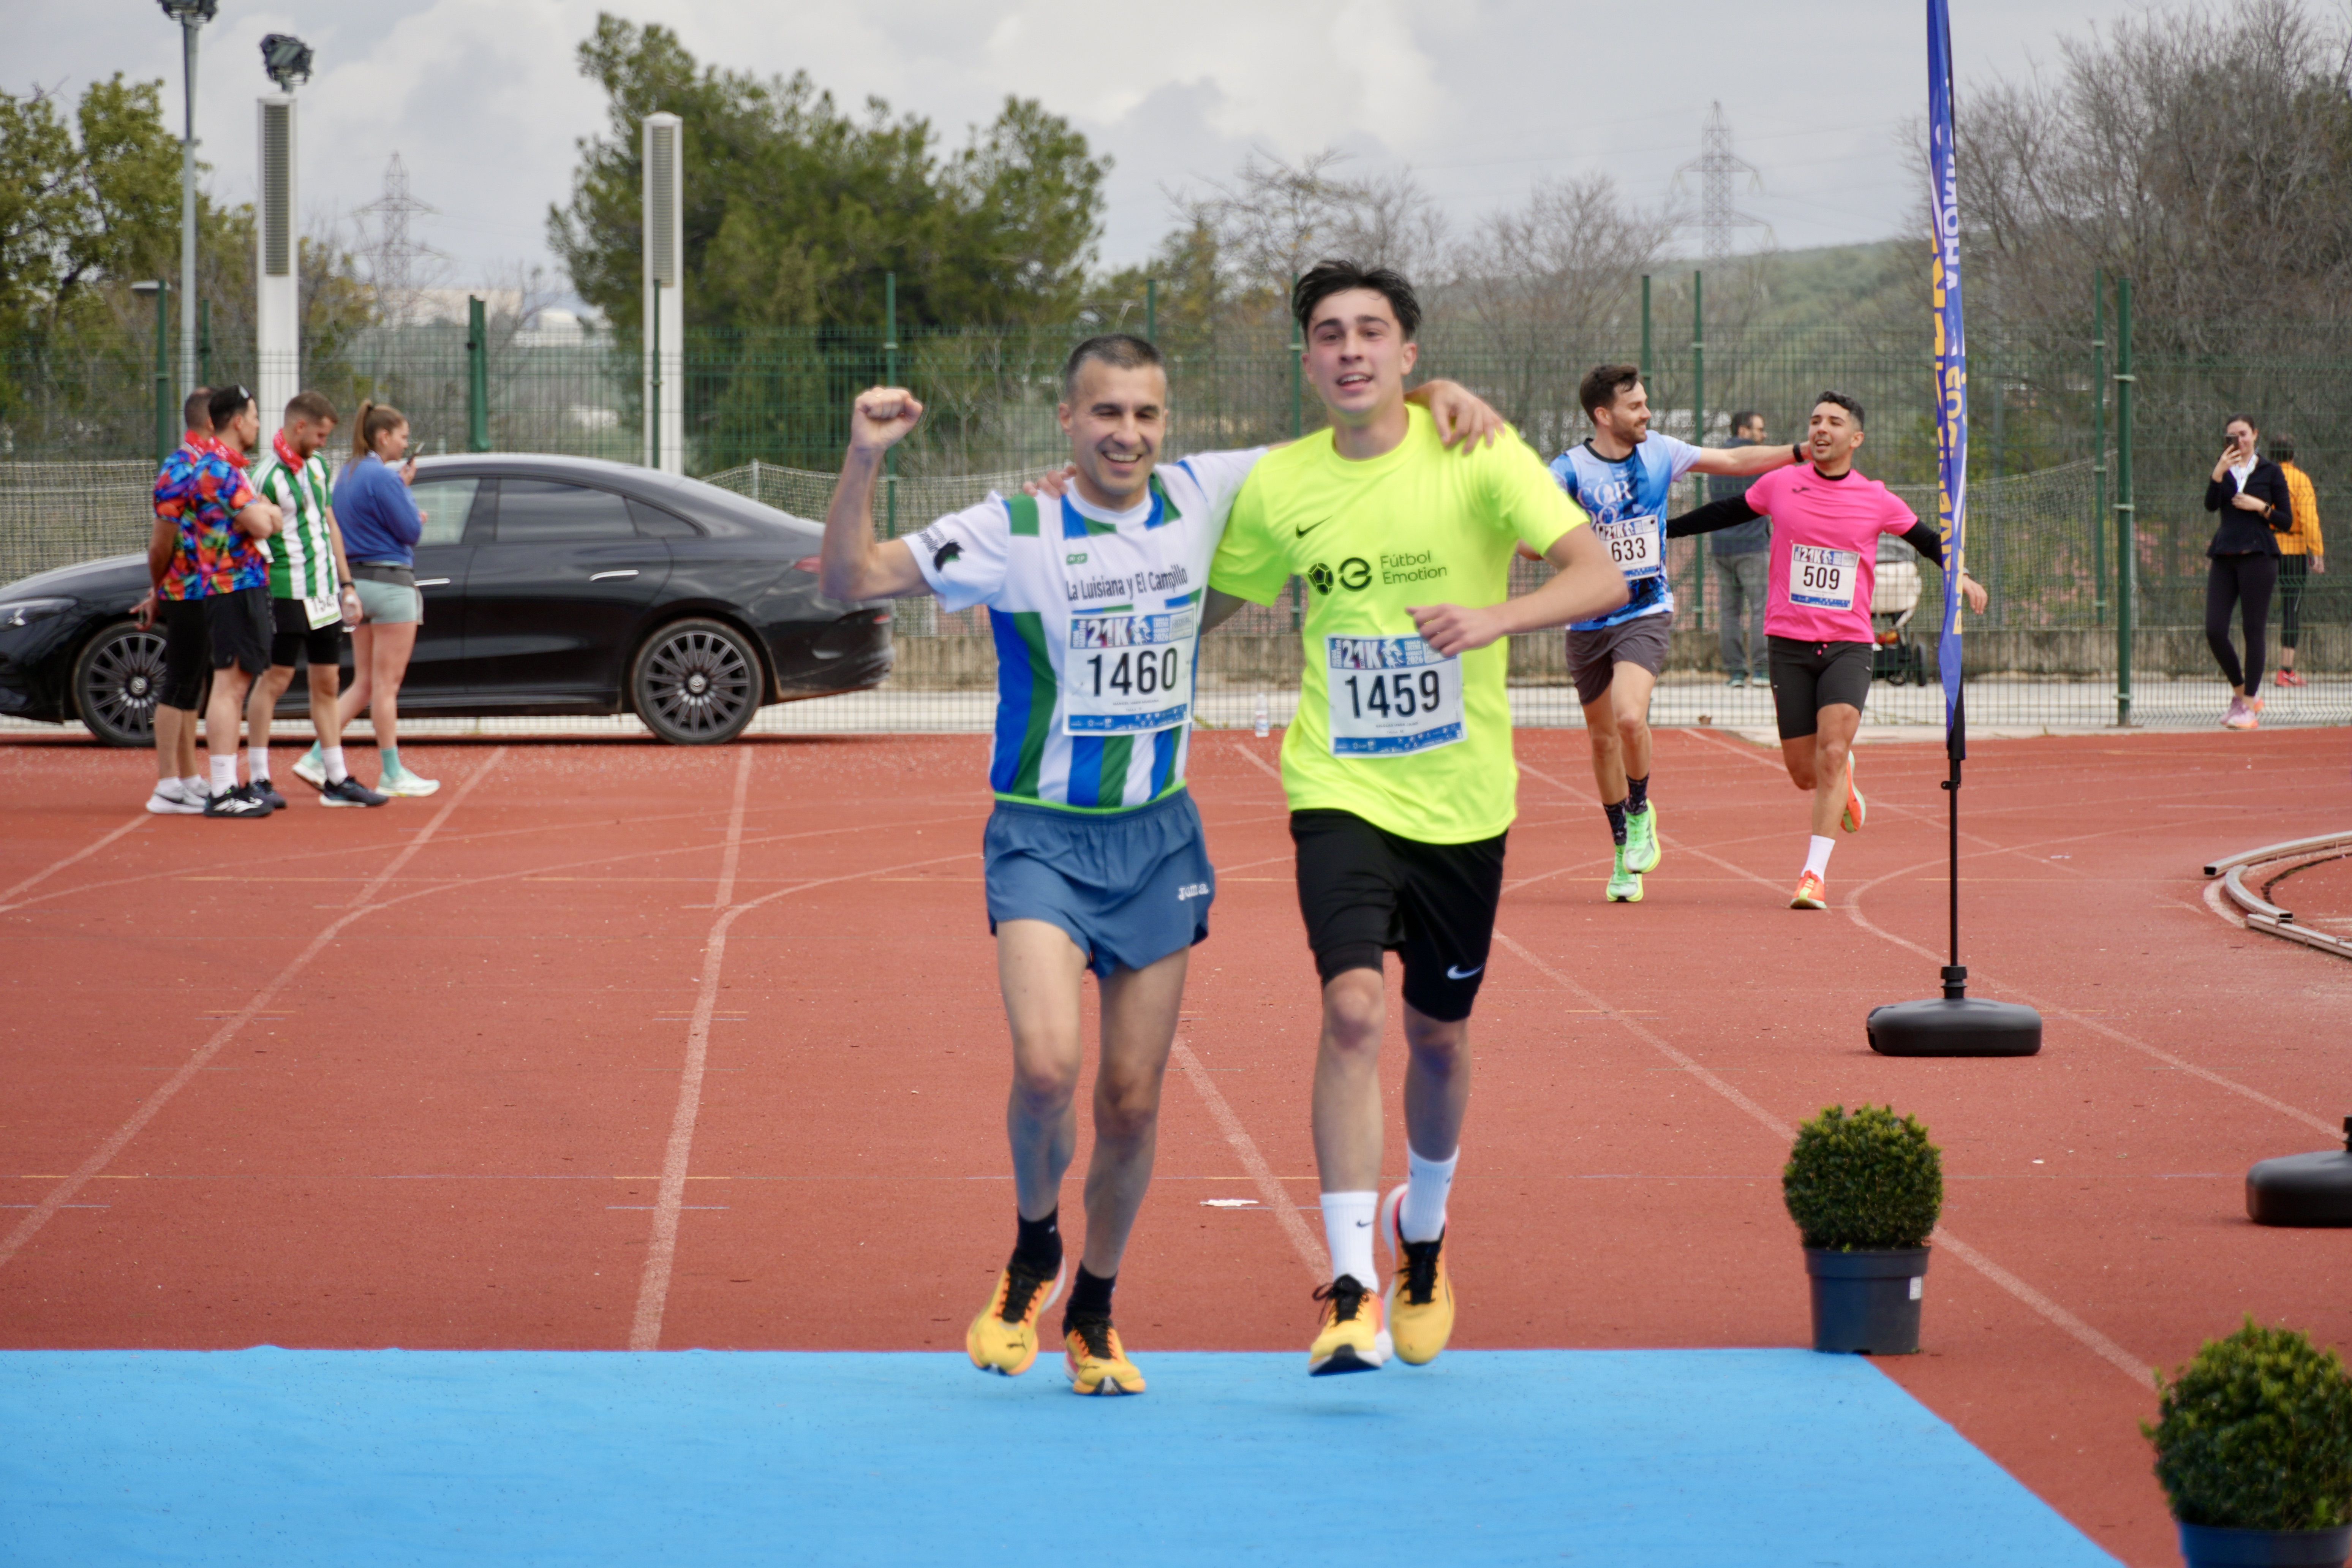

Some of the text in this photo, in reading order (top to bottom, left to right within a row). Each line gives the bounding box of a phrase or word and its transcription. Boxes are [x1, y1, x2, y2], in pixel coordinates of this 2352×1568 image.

[1380, 550, 1431, 569] Fútbol
[1611, 537, 1646, 562] 633
[1066, 564, 1189, 601] La Luisiana y El Campillo
[1382, 566, 1448, 585] Emotion
[1803, 566, 1840, 590] 509
[1088, 618, 1129, 648] 21K
[1343, 640, 1381, 669] 21K
[1407, 655, 1423, 665] 2026
[1087, 647, 1178, 697] 1460
[1345, 670, 1440, 719] 1459
